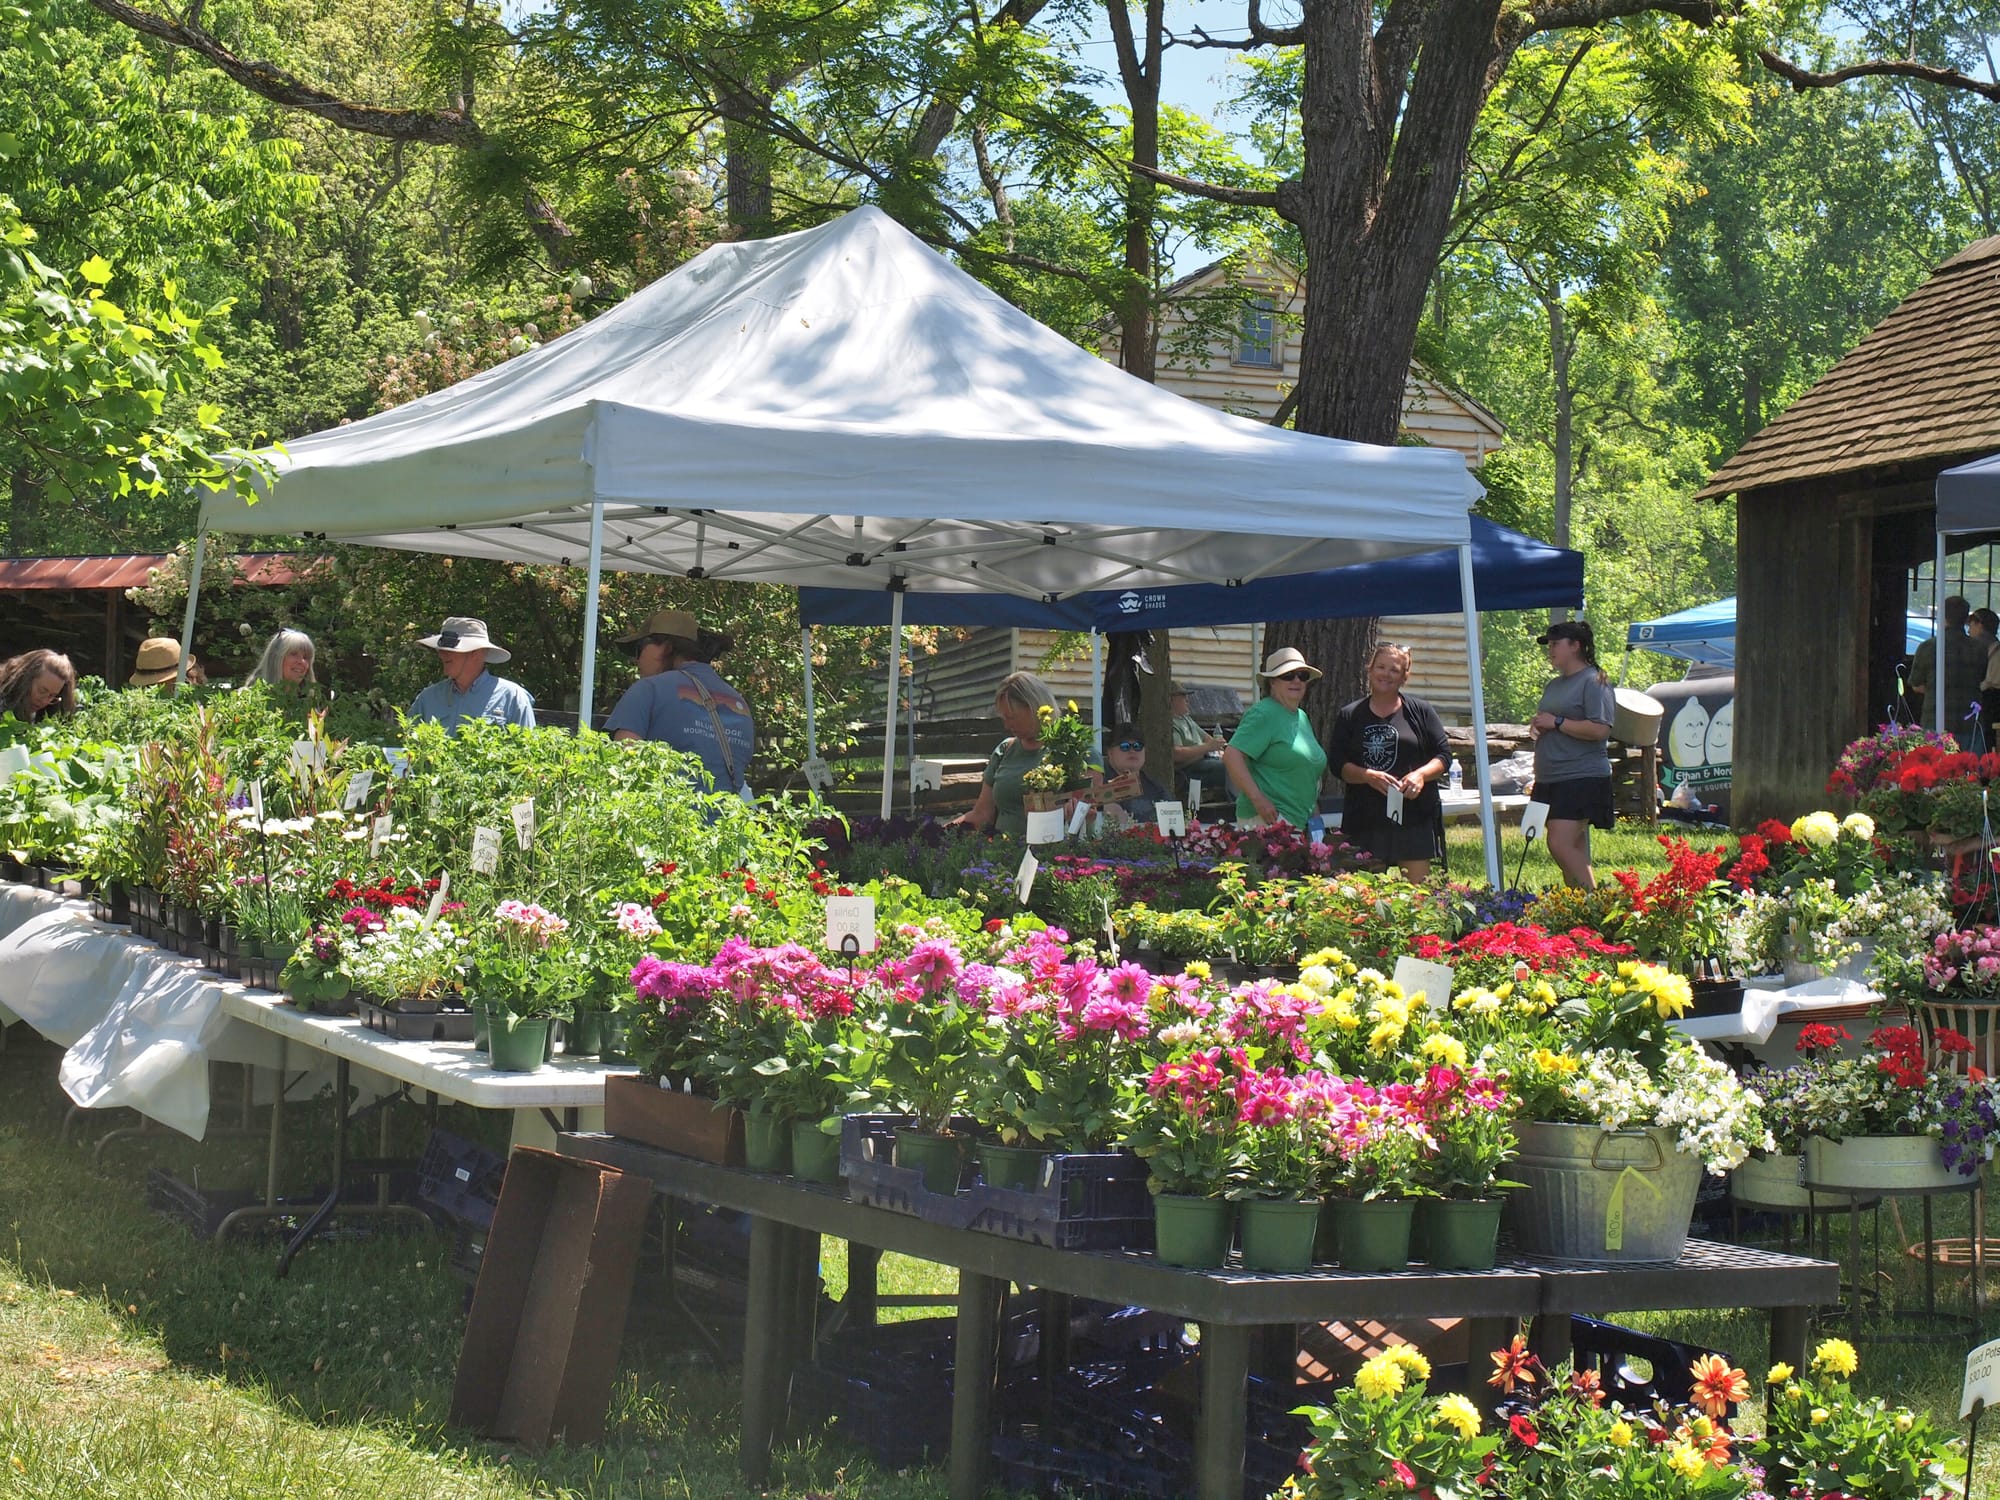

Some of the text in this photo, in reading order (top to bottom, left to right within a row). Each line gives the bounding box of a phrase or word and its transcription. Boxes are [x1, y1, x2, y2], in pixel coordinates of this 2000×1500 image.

[1144, 594, 1166, 602] CROWN
[695, 720, 714, 731] BLUE
[683, 727, 715, 739] MOUNTAIN
[1675, 771, 1701, 781] Ethan
[1703, 769, 1711, 778] &
[1984, 1345, 2000, 1359] Pots
